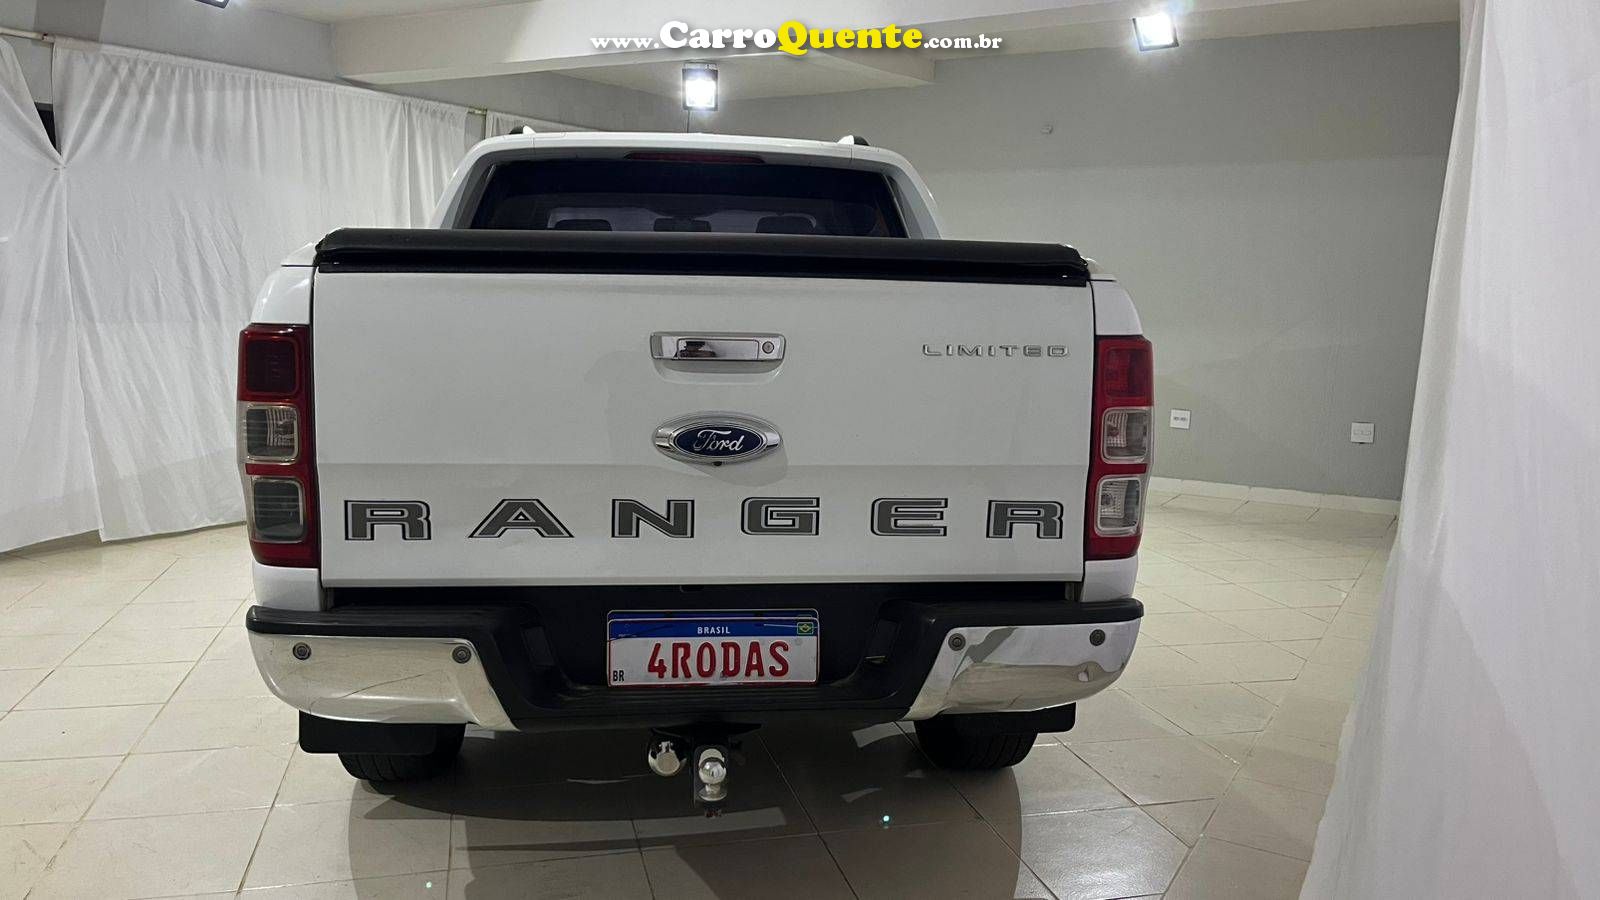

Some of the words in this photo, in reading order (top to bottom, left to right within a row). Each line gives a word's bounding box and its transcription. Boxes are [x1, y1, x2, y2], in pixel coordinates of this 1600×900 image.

[922, 343, 1071, 358] LIMITED
[692, 428, 744, 452] Ford
[344, 497, 1064, 540] RANGER
[697, 626, 731, 635] BRASIL
[647, 640, 790, 679] 4RODAS
[612, 669, 625, 682] BR
